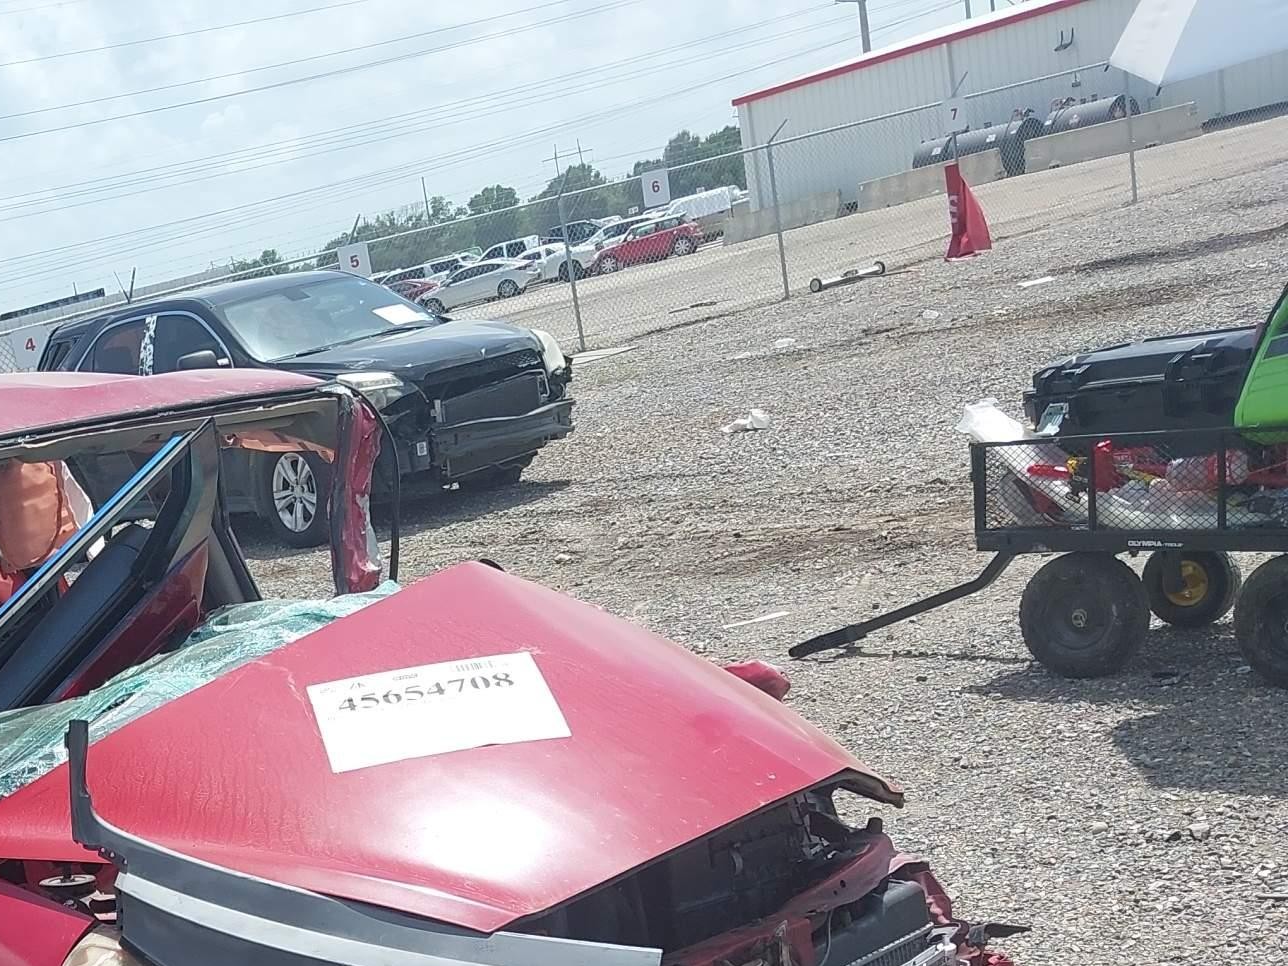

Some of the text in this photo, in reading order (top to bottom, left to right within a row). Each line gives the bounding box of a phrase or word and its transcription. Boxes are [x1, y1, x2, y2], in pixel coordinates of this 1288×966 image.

[950, 108, 958, 121] 7
[652, 180, 660, 193] 6
[350, 254, 360, 268] 5
[25, 337, 36, 351] 4
[338, 672, 515, 711] 45654708
